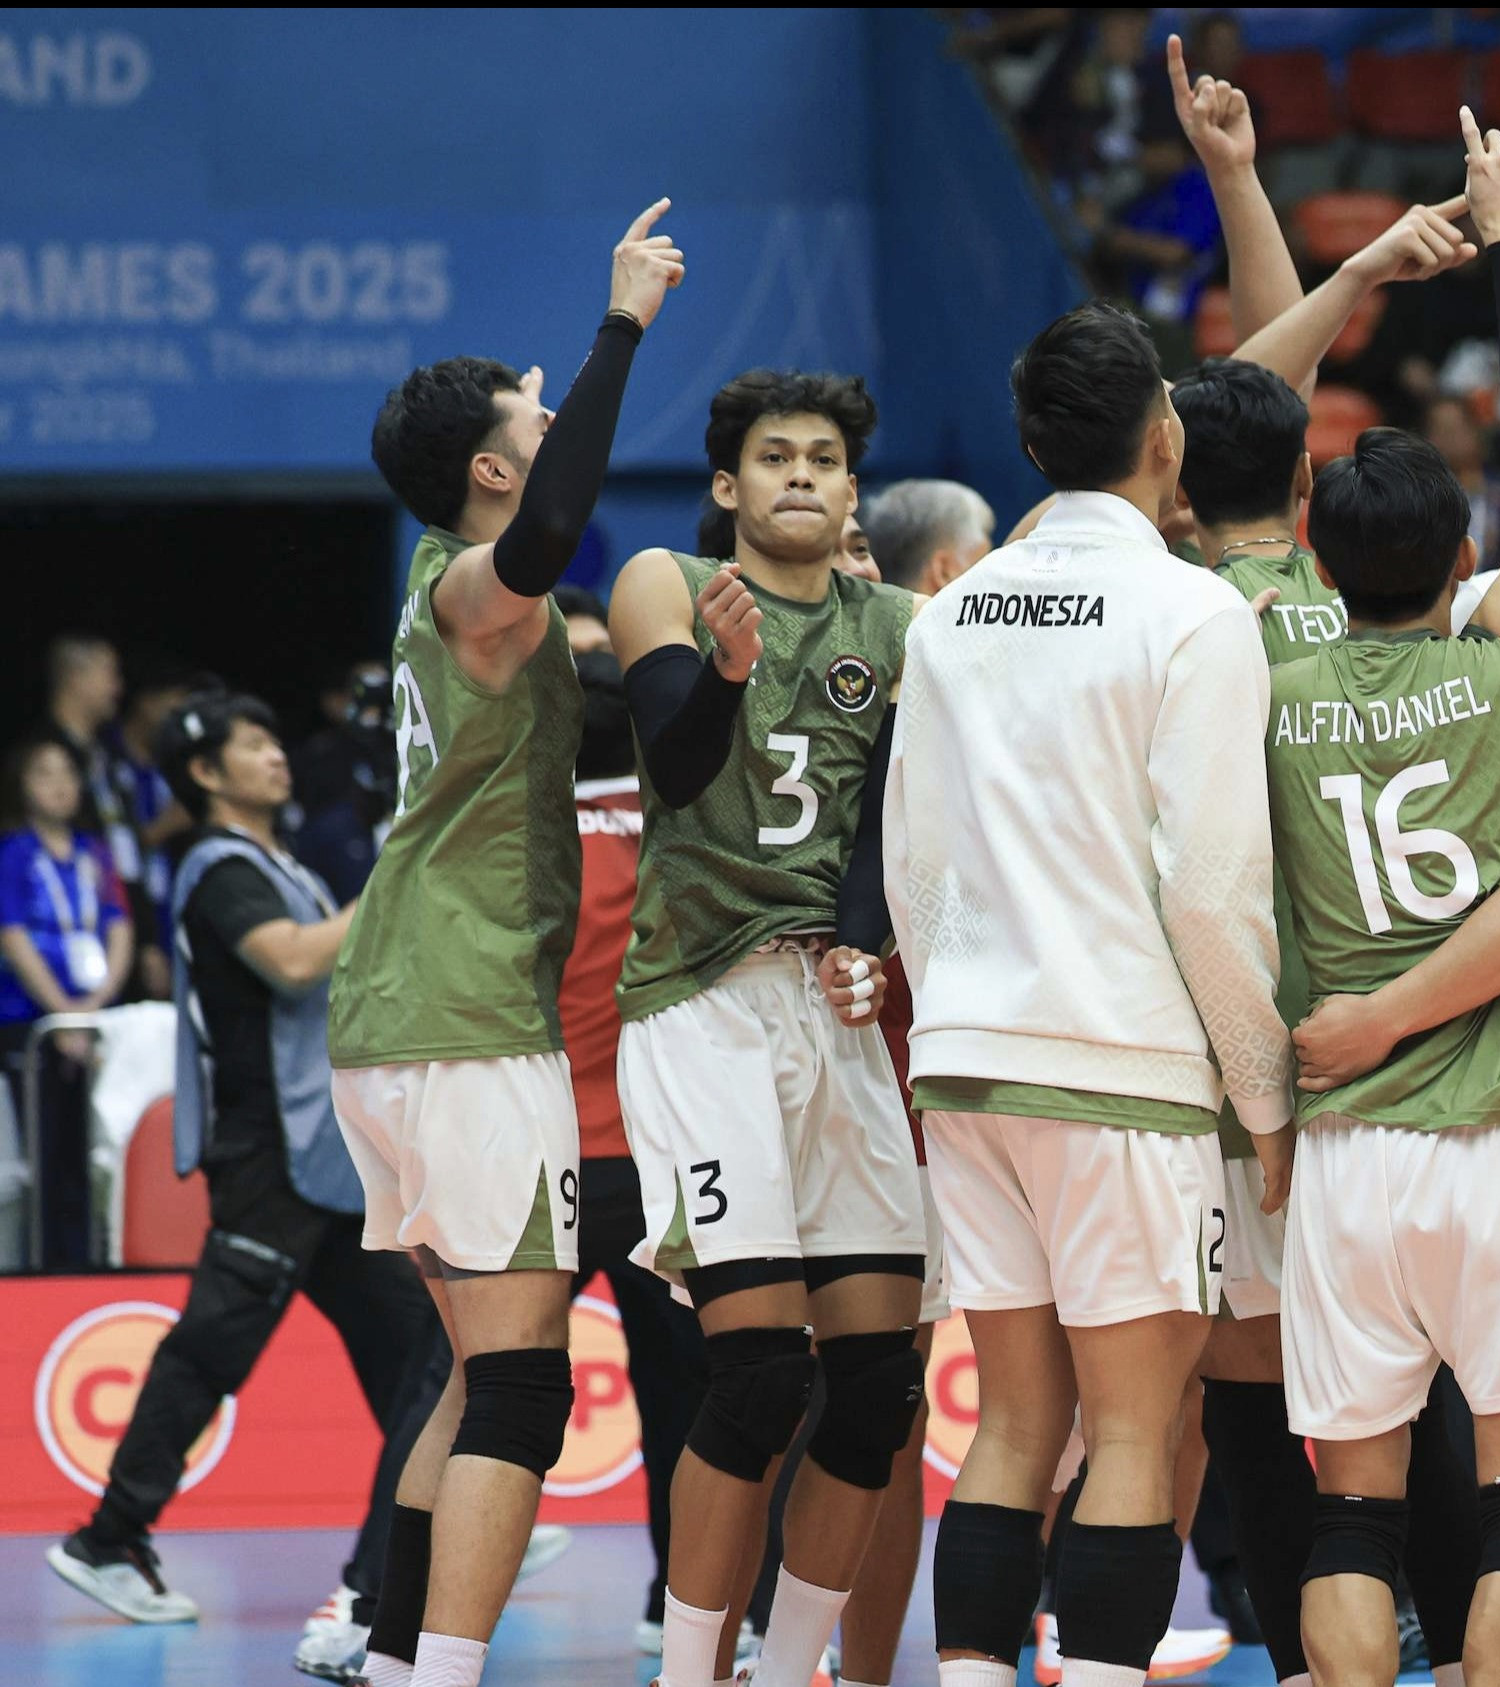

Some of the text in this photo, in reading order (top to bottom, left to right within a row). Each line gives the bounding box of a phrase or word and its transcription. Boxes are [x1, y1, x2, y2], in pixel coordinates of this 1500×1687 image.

[243, 243, 452, 321] 2025
[956, 593, 1104, 627] INDONESIA
[1275, 675, 1492, 746] ALFIN DANIEL
[757, 732, 819, 846] 3
[1319, 759, 1480, 935] 16
[560, 1168, 578, 1230] 9
[690, 1159, 728, 1226] 3
[1209, 1208, 1226, 1273] 2
